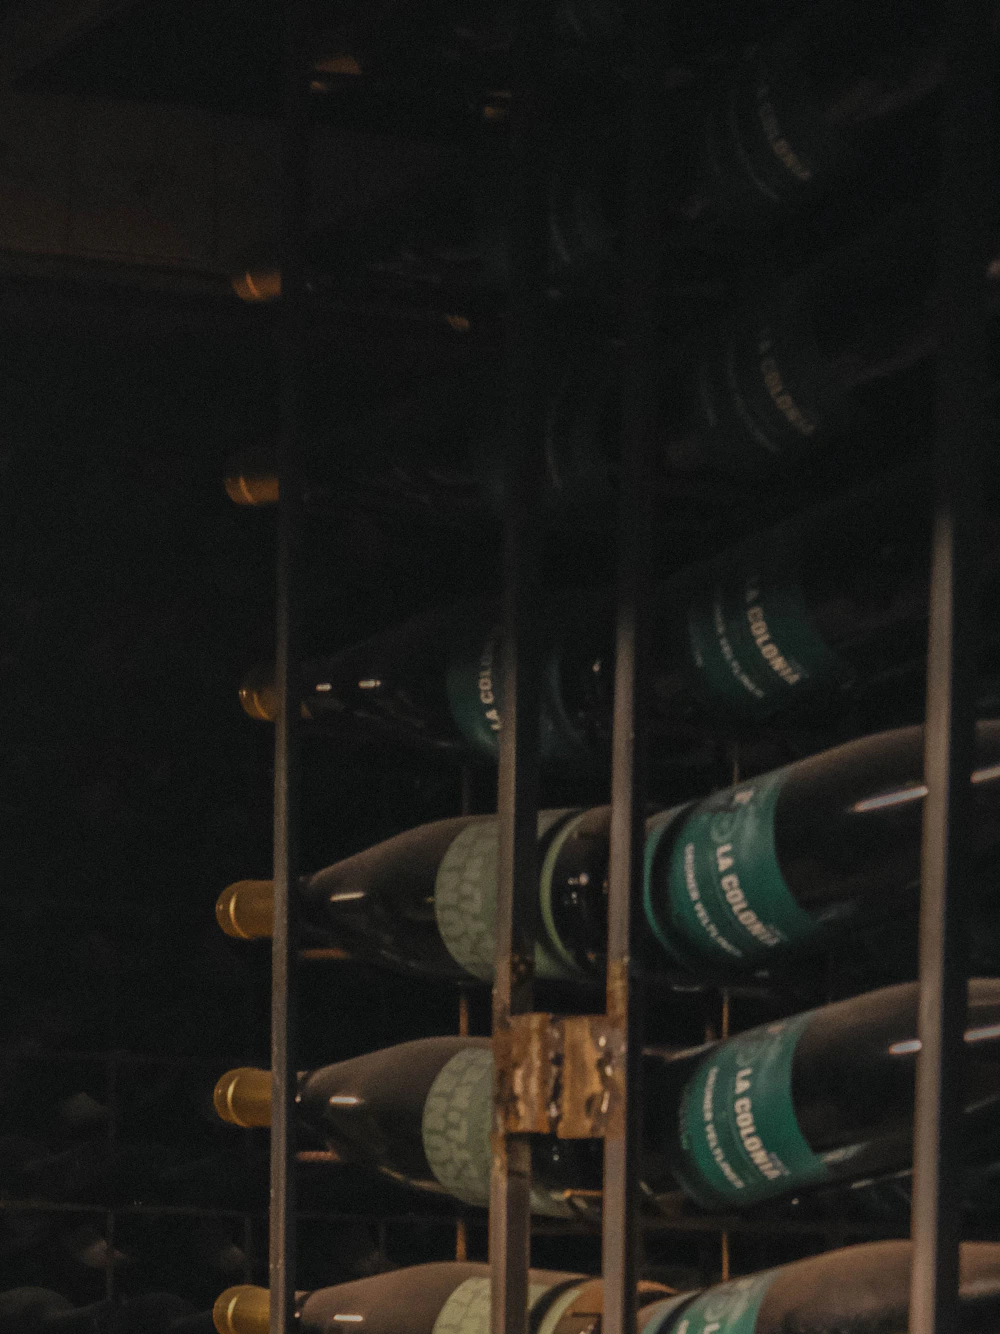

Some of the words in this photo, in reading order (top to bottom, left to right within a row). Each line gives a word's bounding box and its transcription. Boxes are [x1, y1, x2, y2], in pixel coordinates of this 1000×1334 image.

[747, 604, 802, 685] COLONIA
[716, 843, 735, 872] LA
[720, 873, 781, 947] COLONIA
[735, 1067, 753, 1095] LA
[734, 1096, 782, 1181] COLONIA
